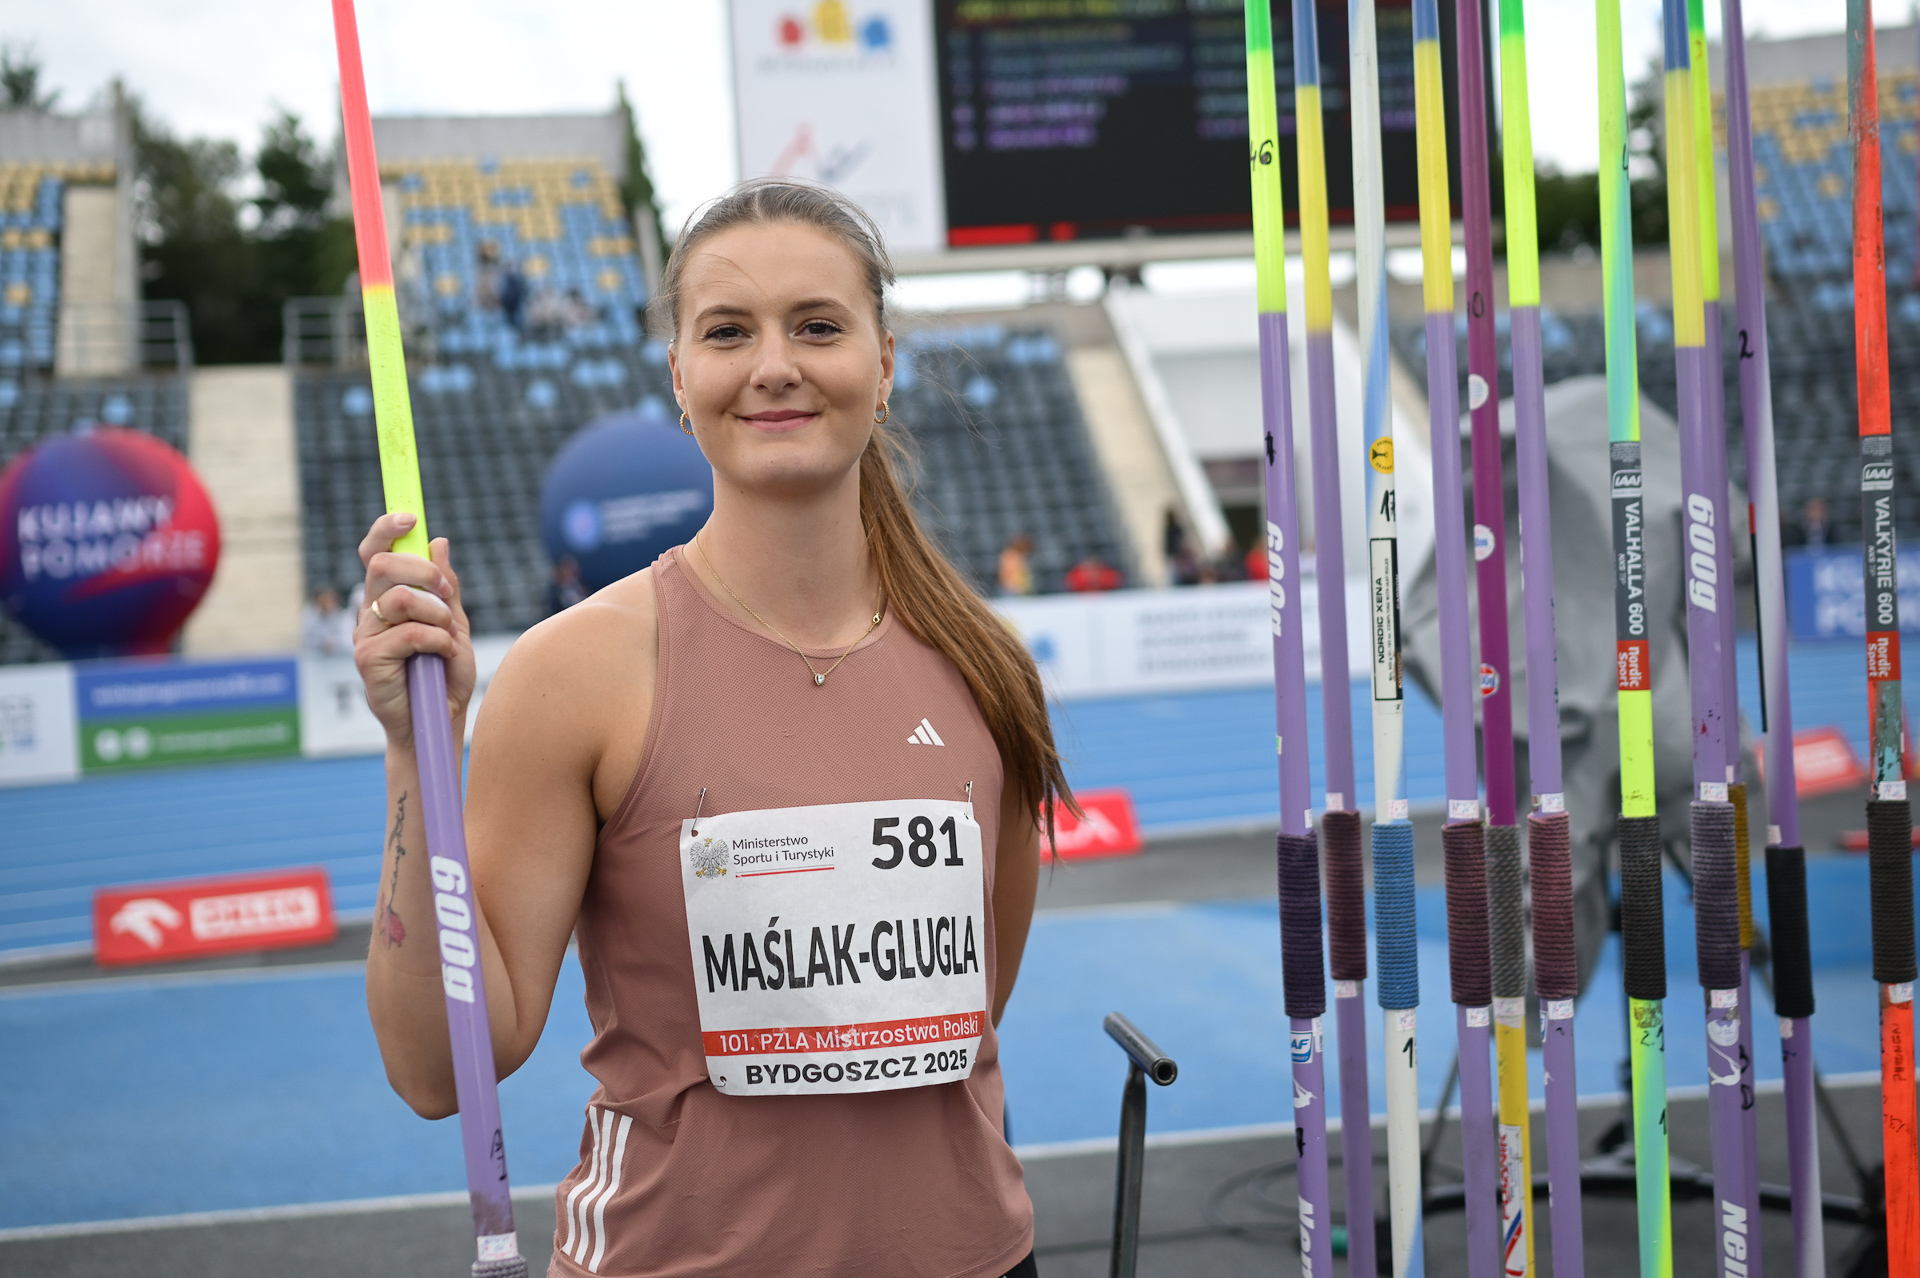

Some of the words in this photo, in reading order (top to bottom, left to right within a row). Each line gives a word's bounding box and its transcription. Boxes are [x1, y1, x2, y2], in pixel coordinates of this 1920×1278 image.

[1625, 501, 1643, 600] VALHALLA
[1687, 493, 1718, 613] 600g
[1874, 496, 1893, 589] VALKYRIE
[1375, 577, 1383, 613] XENA
[1877, 592, 1894, 625] 600
[1376, 616, 1385, 664] NORDIC
[1628, 602, 1644, 636] 600
[732, 834, 809, 851] Ministerstwo
[733, 851, 773, 867] Sportu
[775, 850, 780, 862] i
[781, 846, 835, 864] Turystyki
[872, 815, 964, 870] 581
[430, 855, 476, 1004] 600g
[702, 915, 979, 993] MAŚLAK-GLUGLA
[719, 1034, 755, 1053] 101.
[761, 1033, 810, 1051] PZLA
[815, 1023, 941, 1049] Mistrzostwa
[943, 1015, 979, 1038] Polski
[746, 1056, 918, 1085] BYDGOSZCZ
[923, 1048, 968, 1074] 2025
